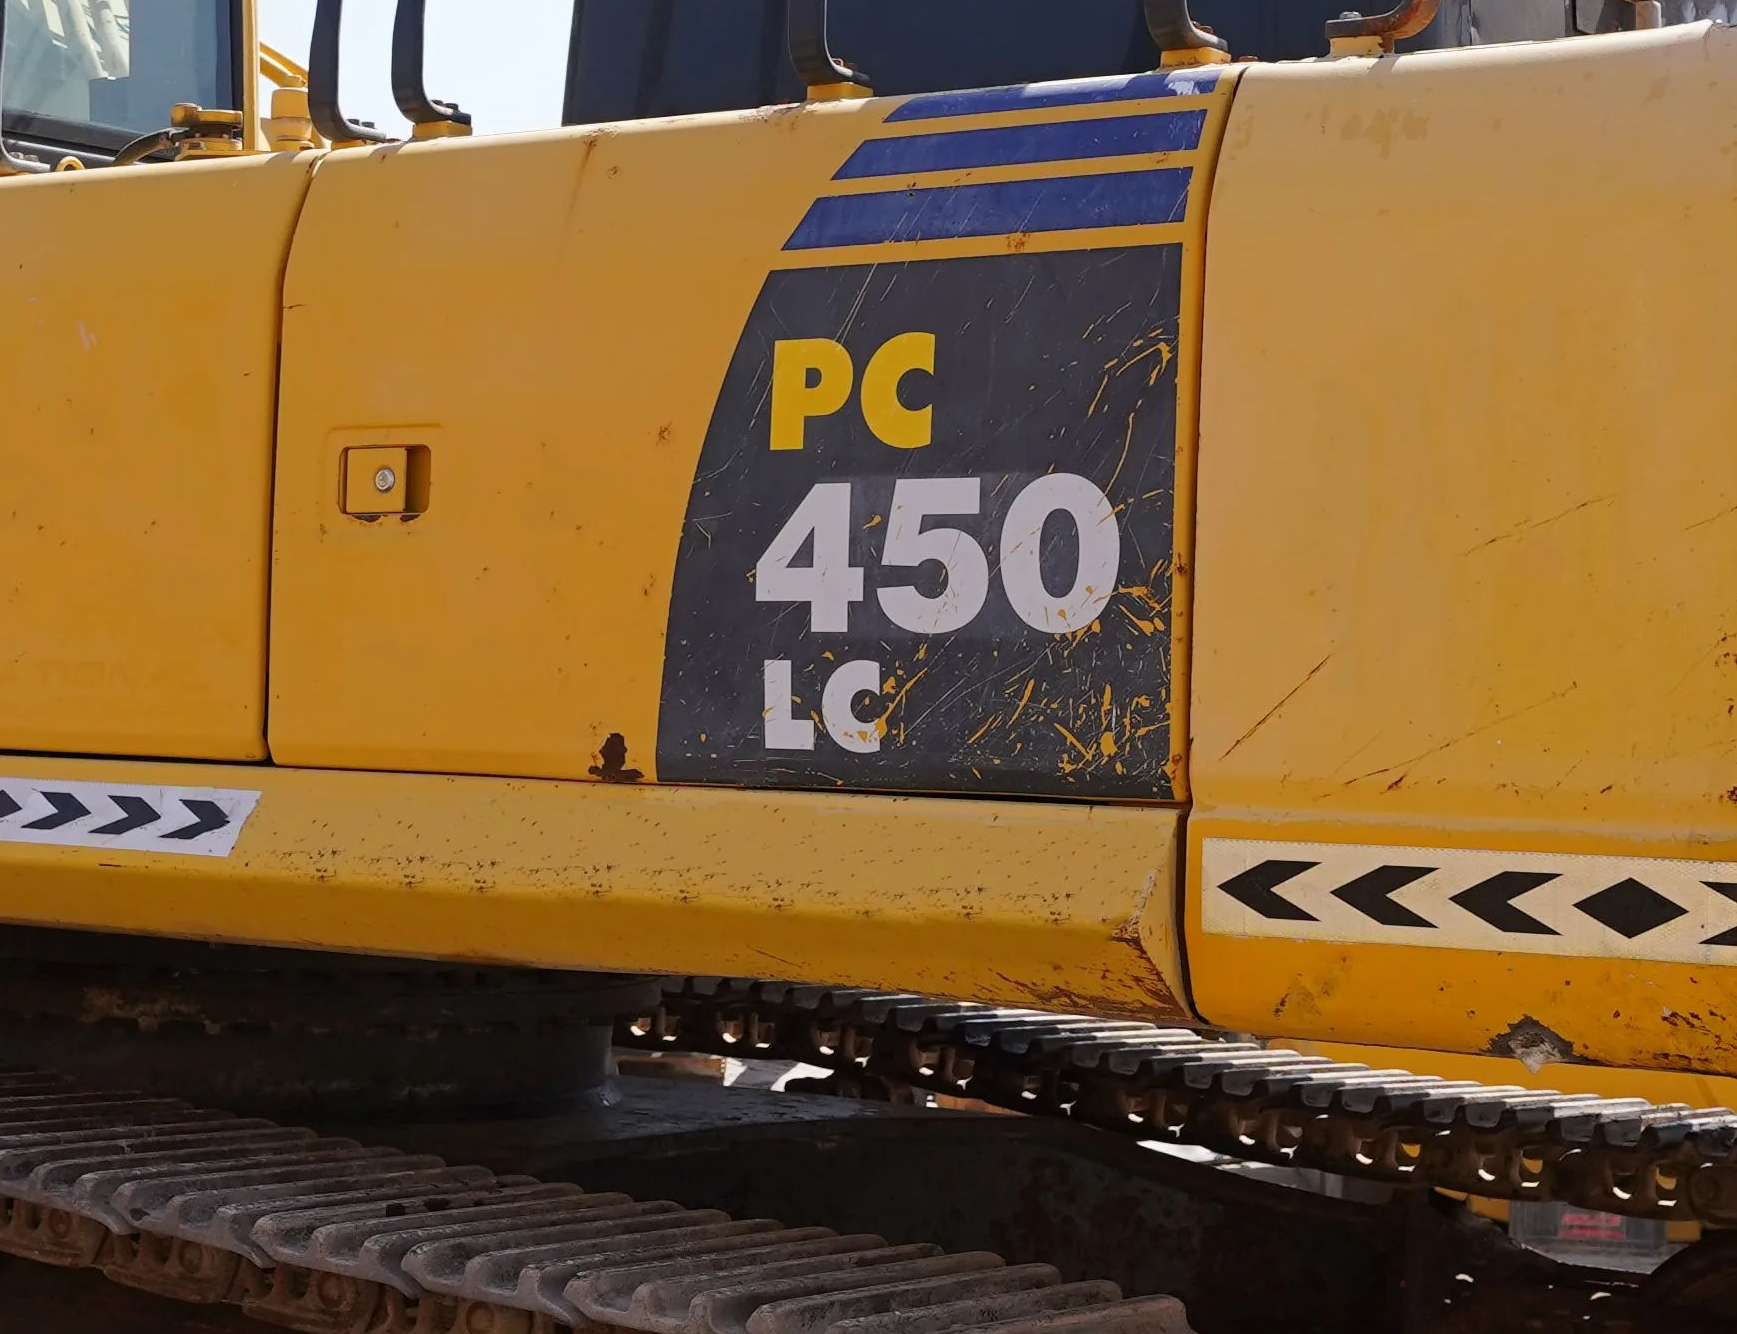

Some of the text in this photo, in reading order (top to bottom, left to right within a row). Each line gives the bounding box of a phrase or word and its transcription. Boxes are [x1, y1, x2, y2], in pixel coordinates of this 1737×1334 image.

[769, 331, 936, 450] PC
[755, 472, 1121, 635] 450
[763, 659, 882, 754] LC
